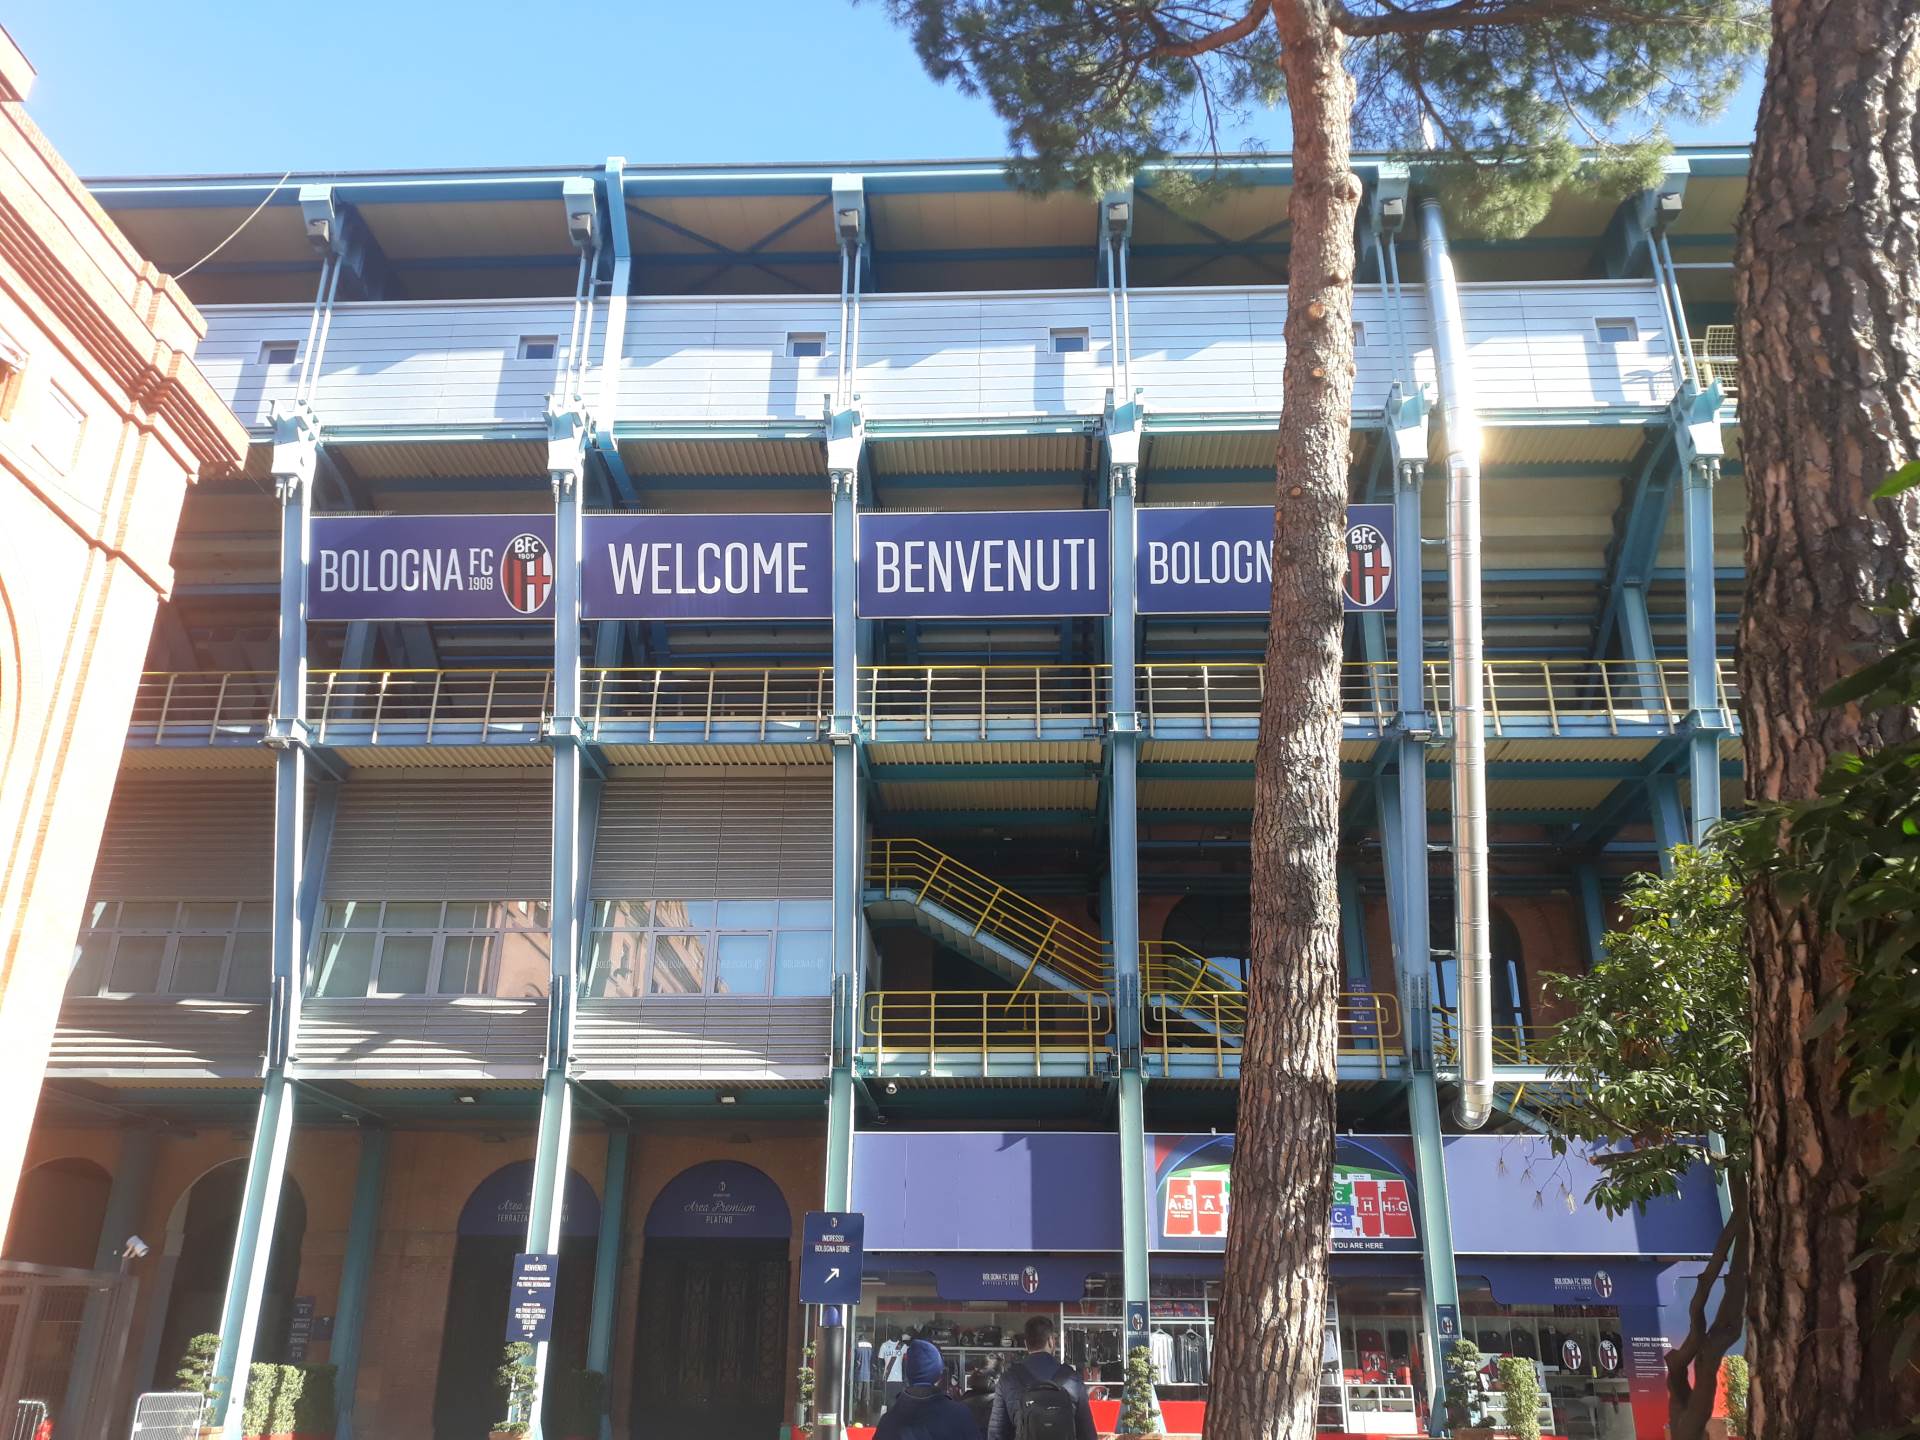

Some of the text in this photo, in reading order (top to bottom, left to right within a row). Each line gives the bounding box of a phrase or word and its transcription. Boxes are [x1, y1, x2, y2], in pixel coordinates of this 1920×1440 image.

[1351, 528, 1377, 545] BFC
[514, 537, 539, 553] BFC
[607, 542, 809, 595] WELCOME
[875, 538, 1096, 593] BENVENUTI
[1148, 539, 1272, 585] BOLOGN
[319, 548, 494, 592] BOLOGNA FC
[468, 576, 494, 591] 1909
[684, 1200, 757, 1212] Area Premium
[1204, 1199, 1215, 1211] A
[1363, 1201, 1373, 1212] H
[705, 1215, 733, 1224] PLATINO
[821, 1234, 845, 1243] INGRESSO
[815, 1244, 851, 1253] BOLOGNA STORE
[1333, 1242, 1384, 1250] YOU ARE HERE
